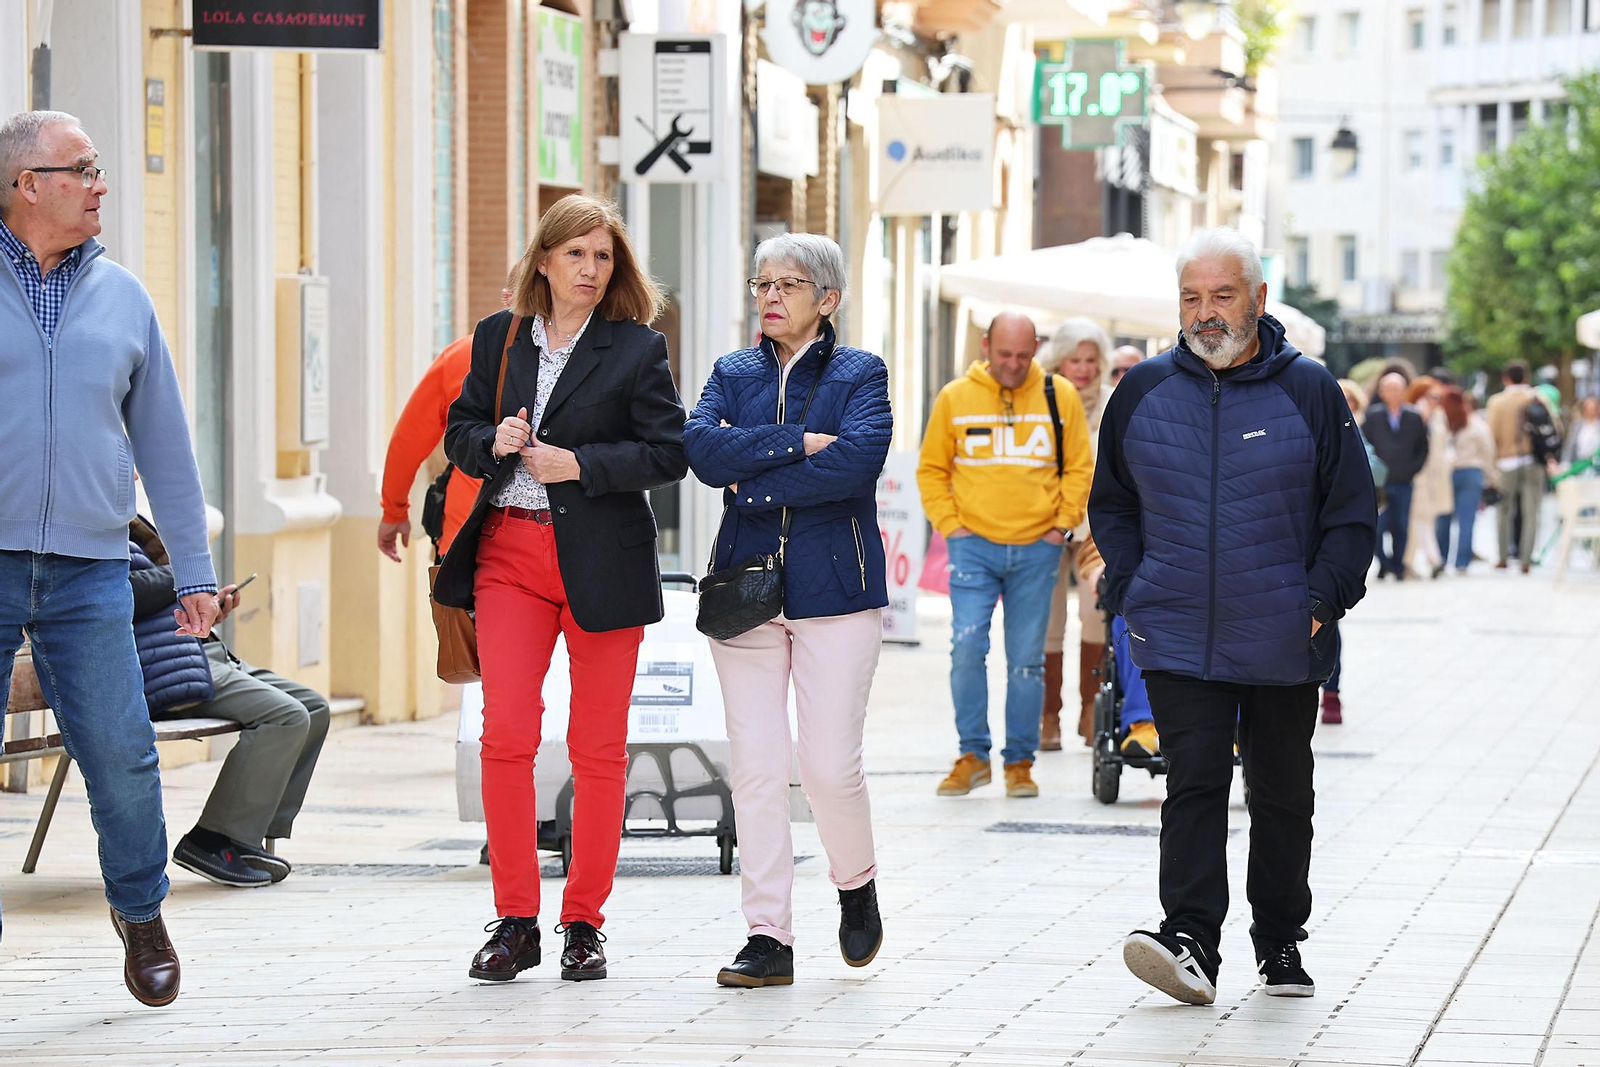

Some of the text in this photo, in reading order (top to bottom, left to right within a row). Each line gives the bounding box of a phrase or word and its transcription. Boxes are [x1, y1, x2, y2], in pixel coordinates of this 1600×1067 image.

[203, 11, 366, 27] LOLA CASADEMUNT
[965, 425, 1053, 456] FILA
